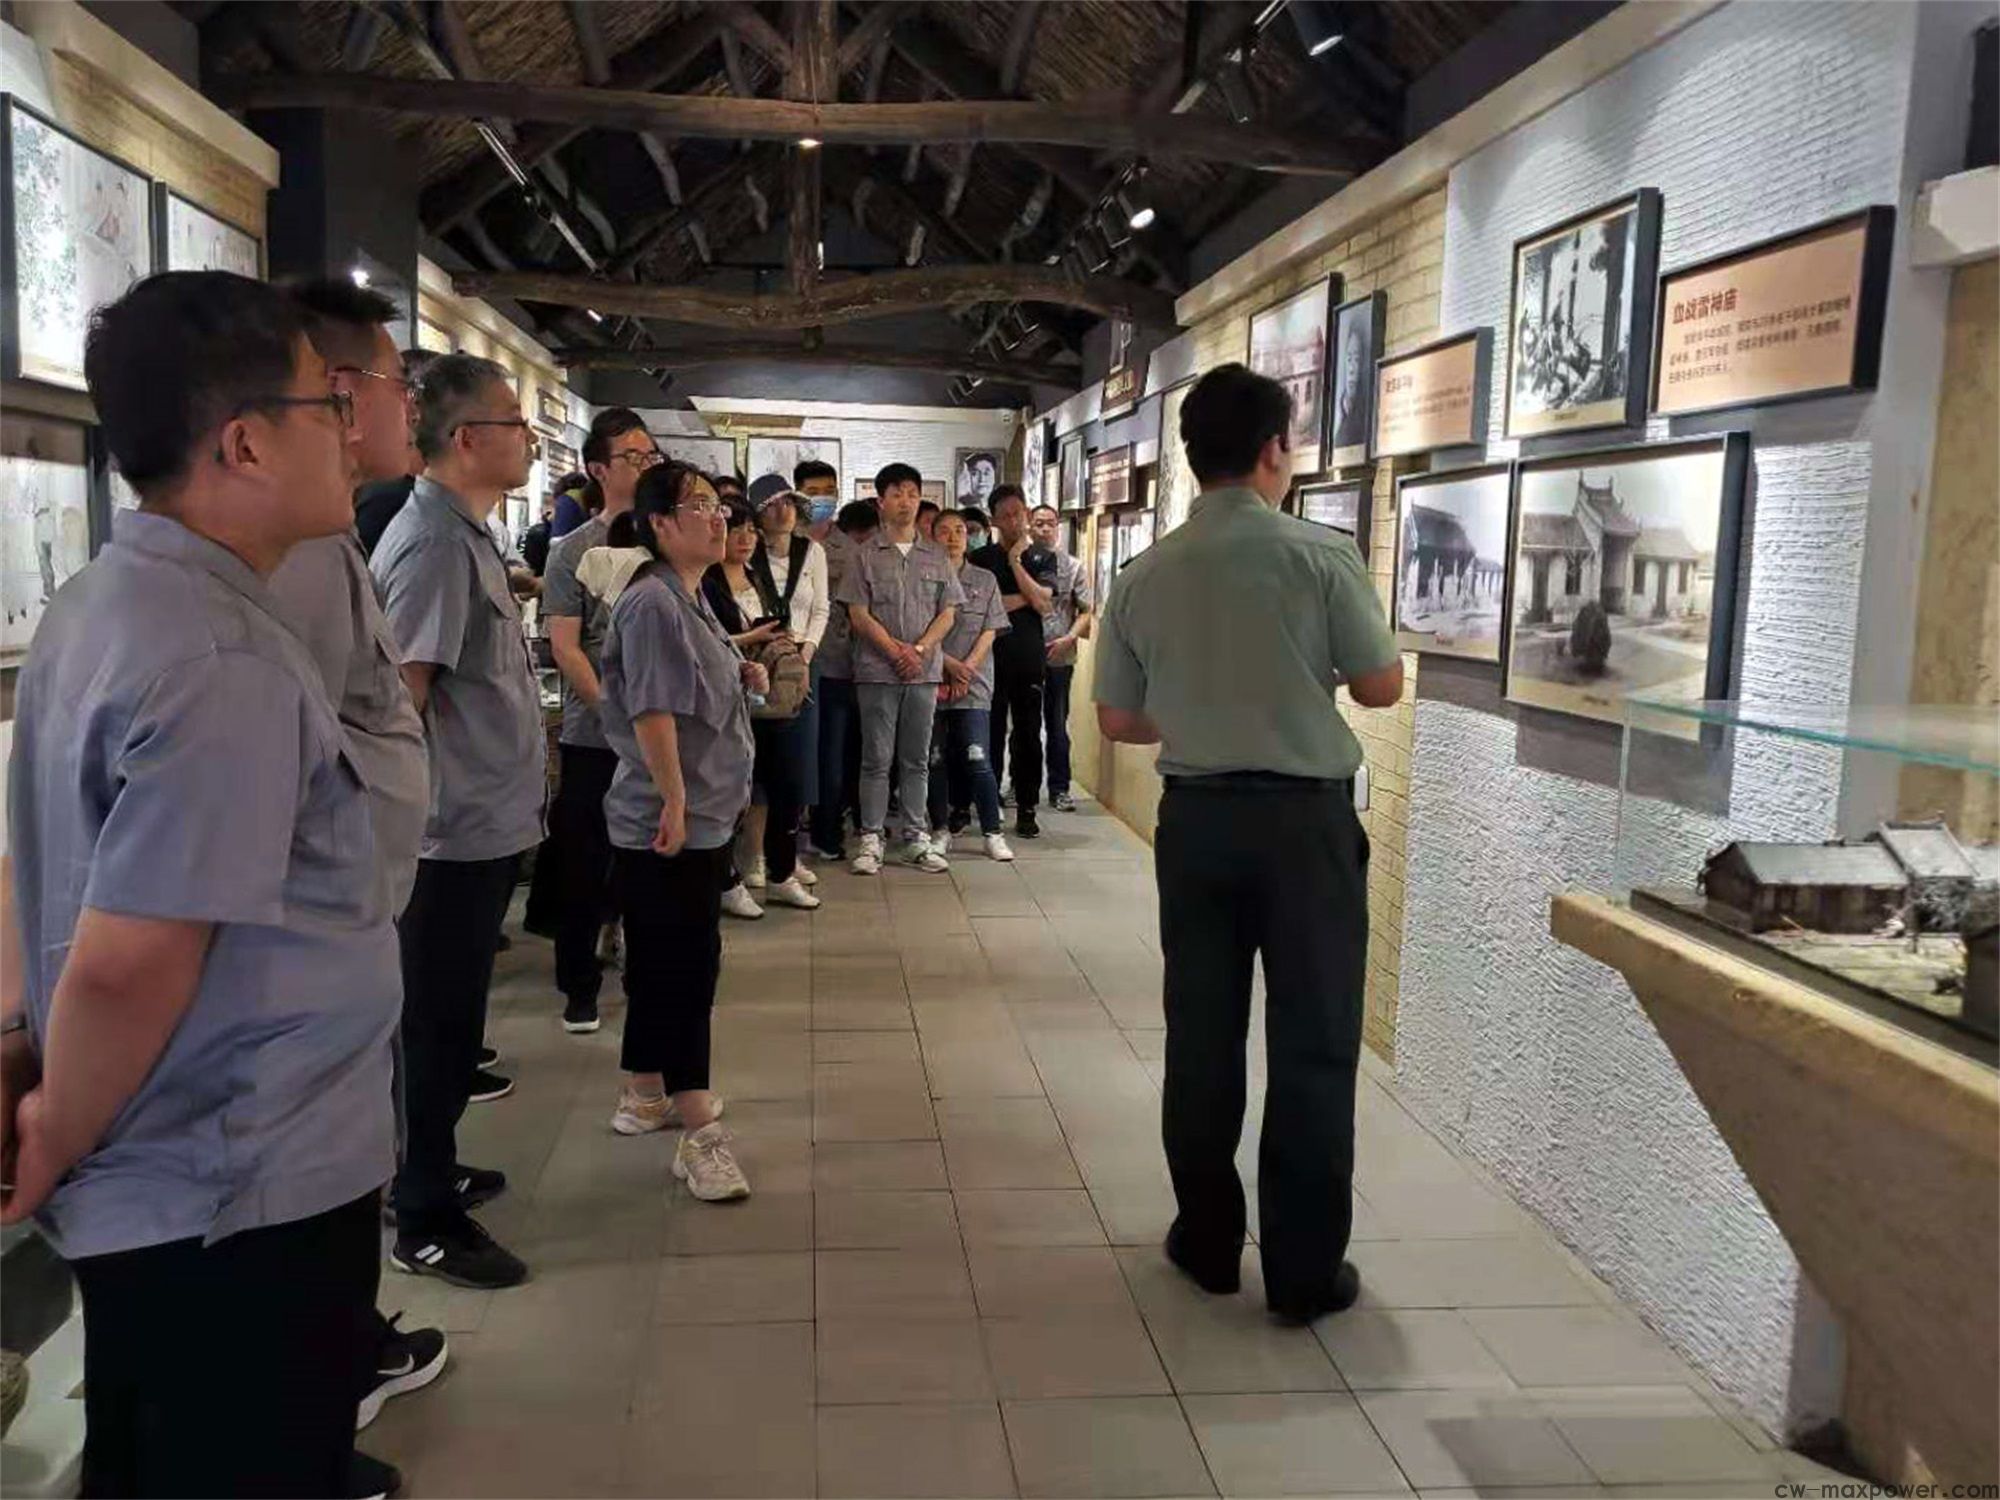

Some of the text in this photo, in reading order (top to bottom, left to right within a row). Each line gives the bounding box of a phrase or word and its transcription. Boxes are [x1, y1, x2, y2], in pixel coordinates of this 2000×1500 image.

[1672, 288, 1738, 325] 血战雷神庙
